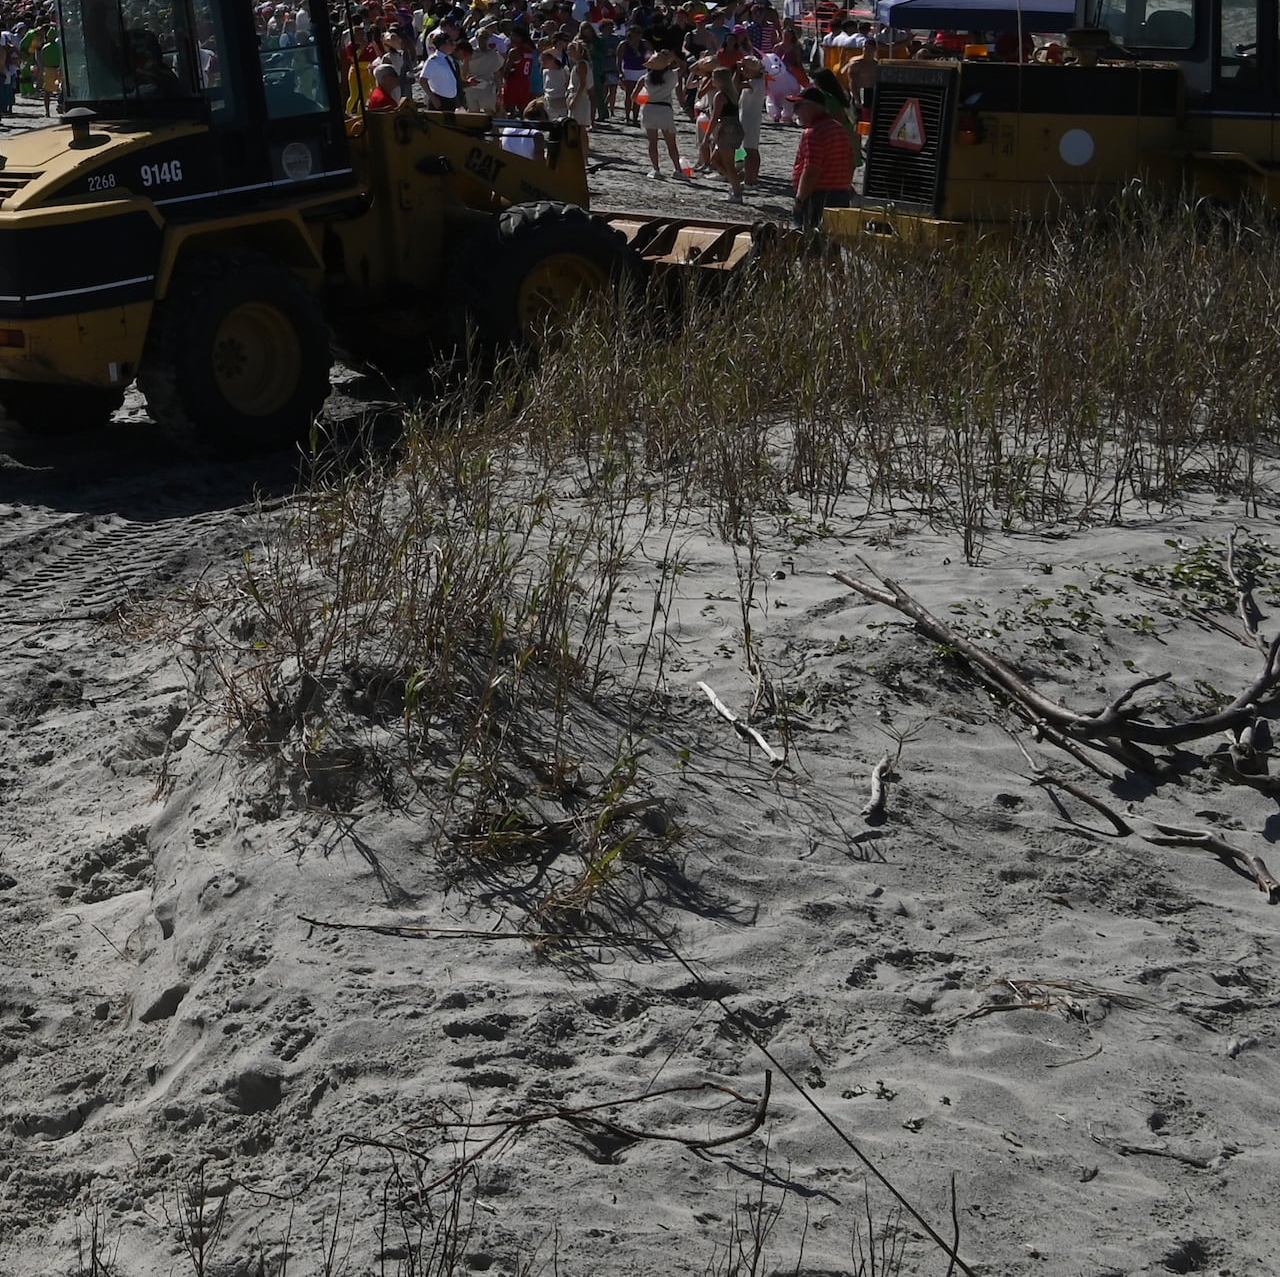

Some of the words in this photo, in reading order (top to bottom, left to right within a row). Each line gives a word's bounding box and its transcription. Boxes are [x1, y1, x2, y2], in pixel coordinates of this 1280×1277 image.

[523, 60, 531, 75] 8
[140, 159, 183, 187] 914G
[464, 147, 506, 182] CAT
[87, 173, 117, 192] 2268
